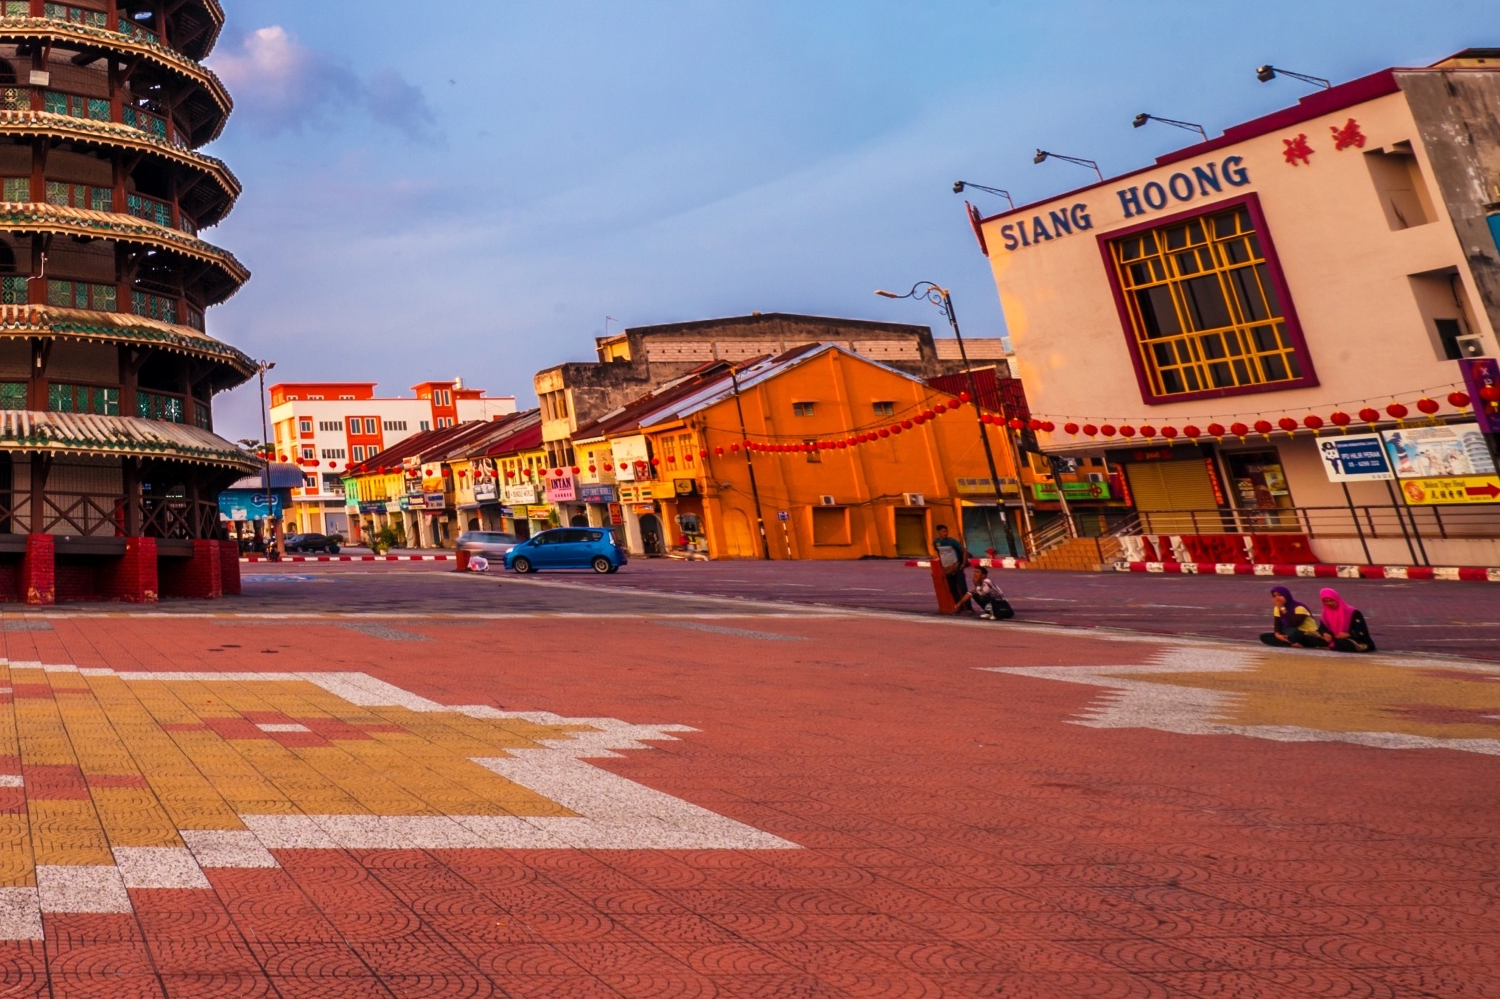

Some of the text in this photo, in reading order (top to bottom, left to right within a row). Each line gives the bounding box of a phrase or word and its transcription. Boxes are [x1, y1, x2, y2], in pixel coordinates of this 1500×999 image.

[1000, 155, 1251, 251] SIANG HOONG
[1363, 451, 1381, 459] PERAK
